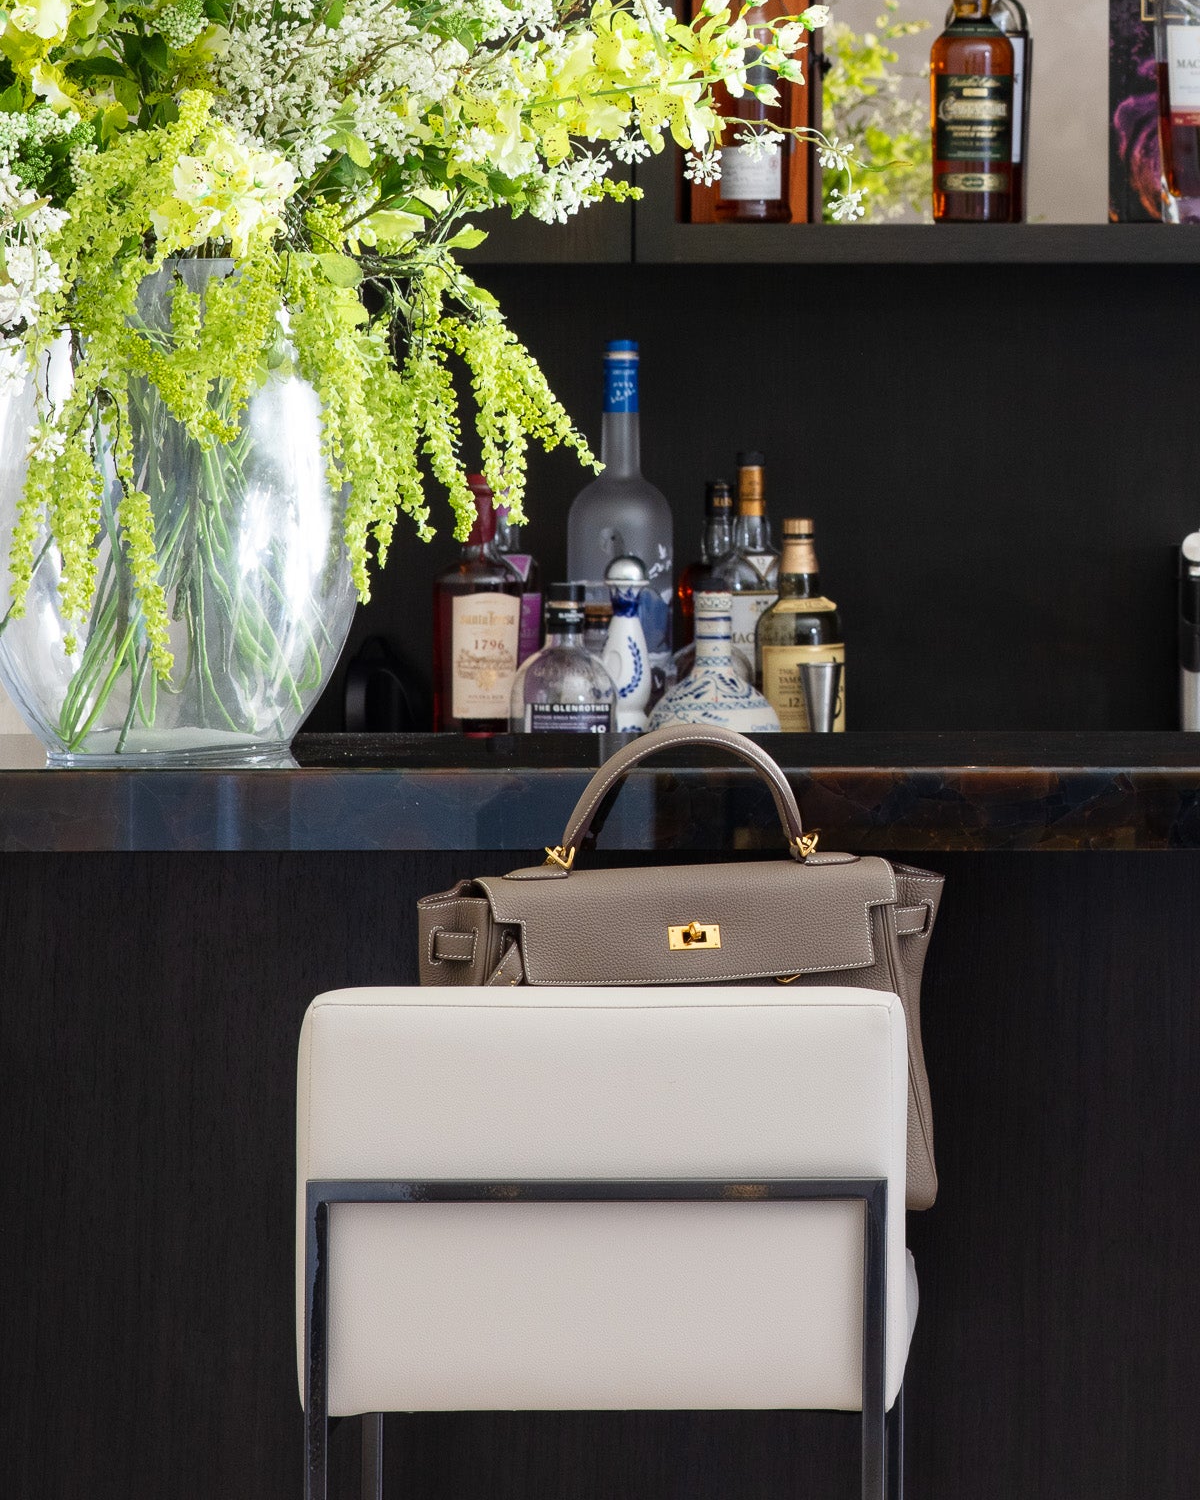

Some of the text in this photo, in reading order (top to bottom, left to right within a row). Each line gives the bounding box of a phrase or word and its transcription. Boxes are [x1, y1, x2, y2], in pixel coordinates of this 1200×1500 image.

[474, 640, 505, 650] 1796
[788, 697, 800, 708] 12
[533, 703, 610, 713] THE GLENROTHES
